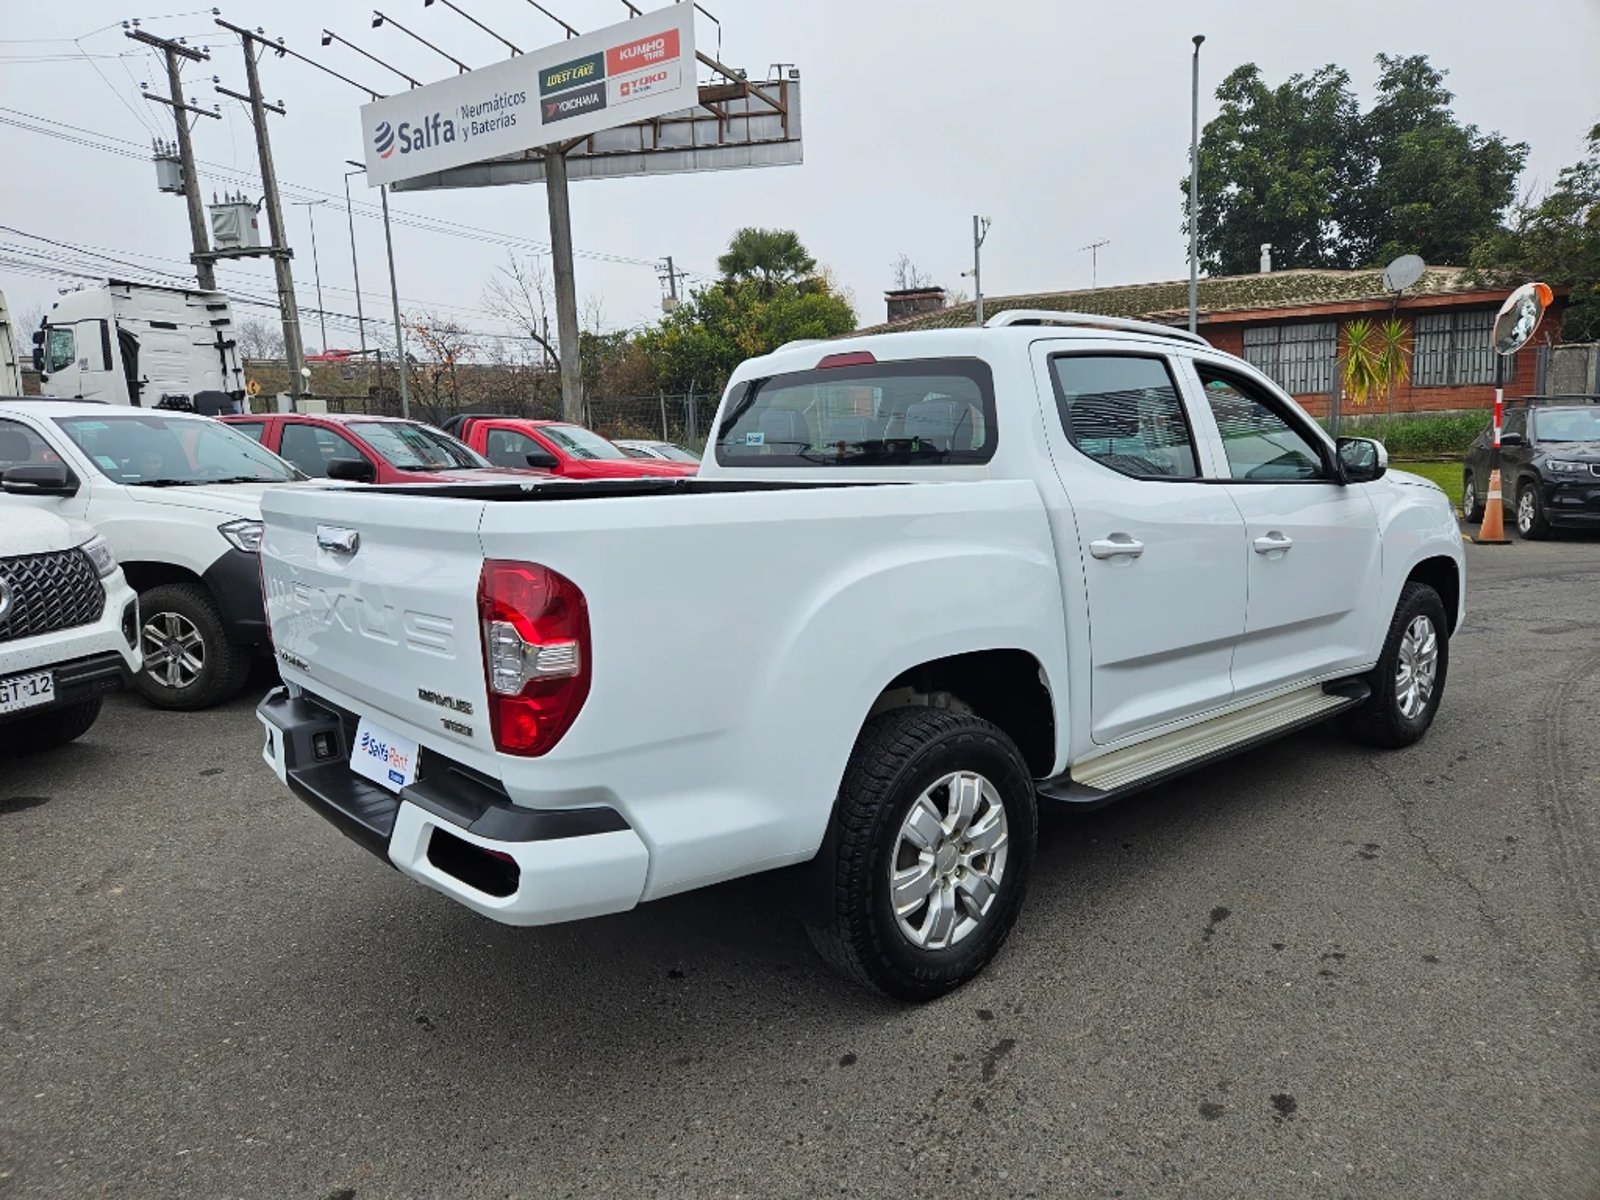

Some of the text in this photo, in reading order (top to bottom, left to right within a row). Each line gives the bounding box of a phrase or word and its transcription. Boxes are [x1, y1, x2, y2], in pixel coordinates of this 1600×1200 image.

[620, 38, 665, 60] KUMHO
[630, 71, 668, 88] YOKO
[461, 91, 526, 119] Neumáticos
[557, 93, 600, 112] YOKOHAMA
[398, 112, 456, 154] Salfa
[462, 111, 517, 142] y Baterías
